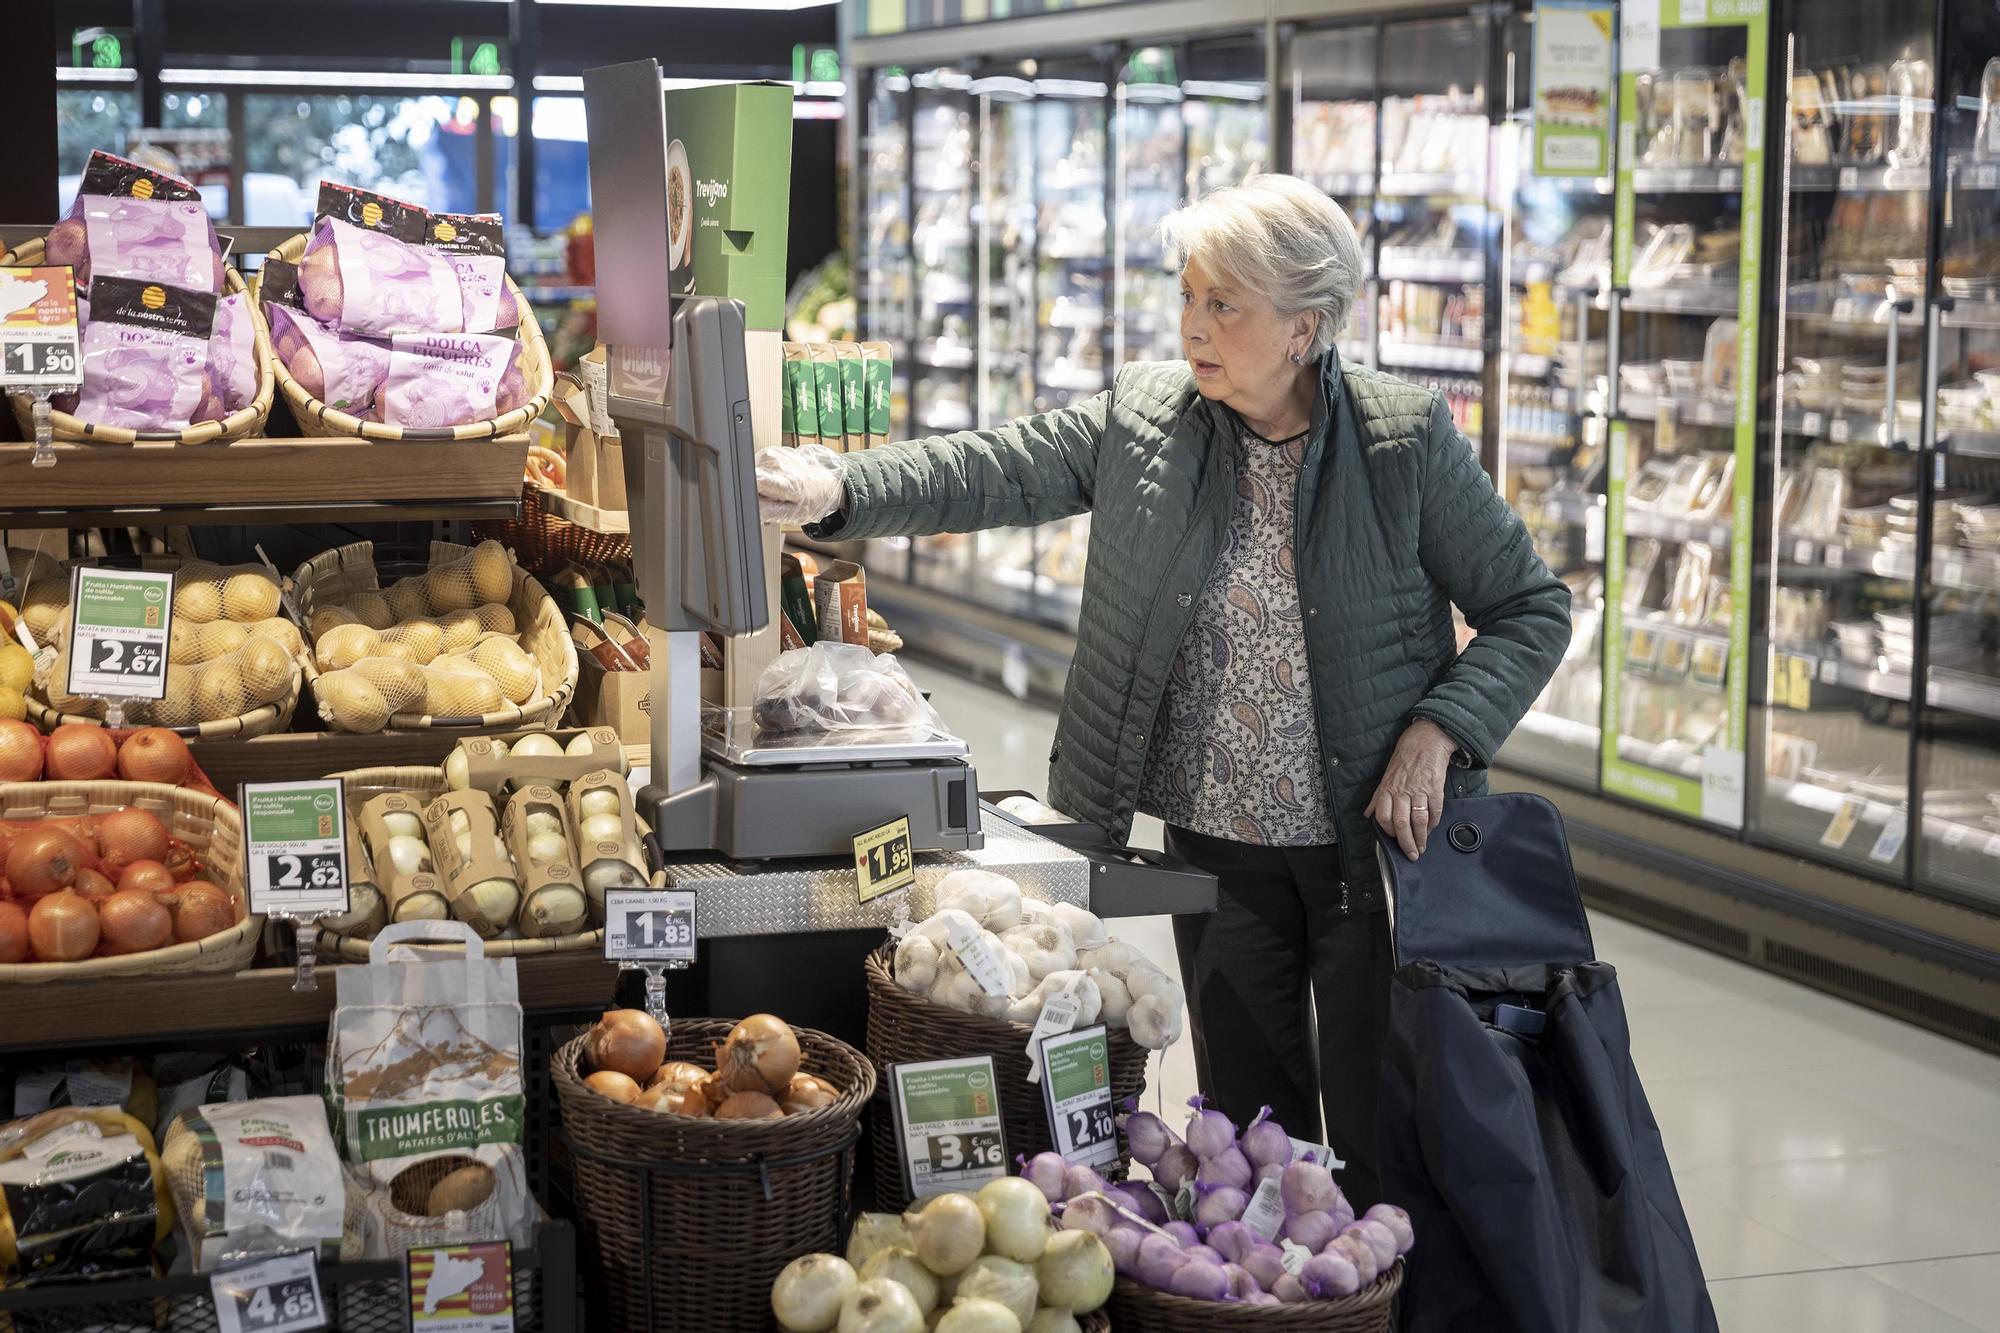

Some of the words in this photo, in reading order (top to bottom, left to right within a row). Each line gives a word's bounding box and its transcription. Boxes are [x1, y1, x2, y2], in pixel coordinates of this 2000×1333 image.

[470, 43, 500, 75] 4
[696, 178, 728, 207] Trevijano
[38, 306, 67, 315] nostra
[116, 306, 127, 315] de
[135, 311, 165, 322] nostra
[14, 343, 74, 374] 1,90
[412, 346, 493, 369] FIGUERES
[444, 366, 454, 375] de
[456, 368, 475, 379] salut
[84, 594, 125, 602] responsable
[99, 640, 161, 675] 2,67
[253, 808, 295, 816] responsable
[277, 854, 340, 890] 2,62
[873, 844, 909, 877] 1,95
[635, 911, 691, 947] 1,83
[366, 1101, 506, 1142] TRUMFEROLES
[1072, 1110, 1113, 1146] 2,10
[398, 1134, 444, 1150] PATATES
[937, 1134, 1002, 1169] 3,16
[247, 1286, 315, 1323] 4,65
[472, 1291, 504, 1300] nostra
